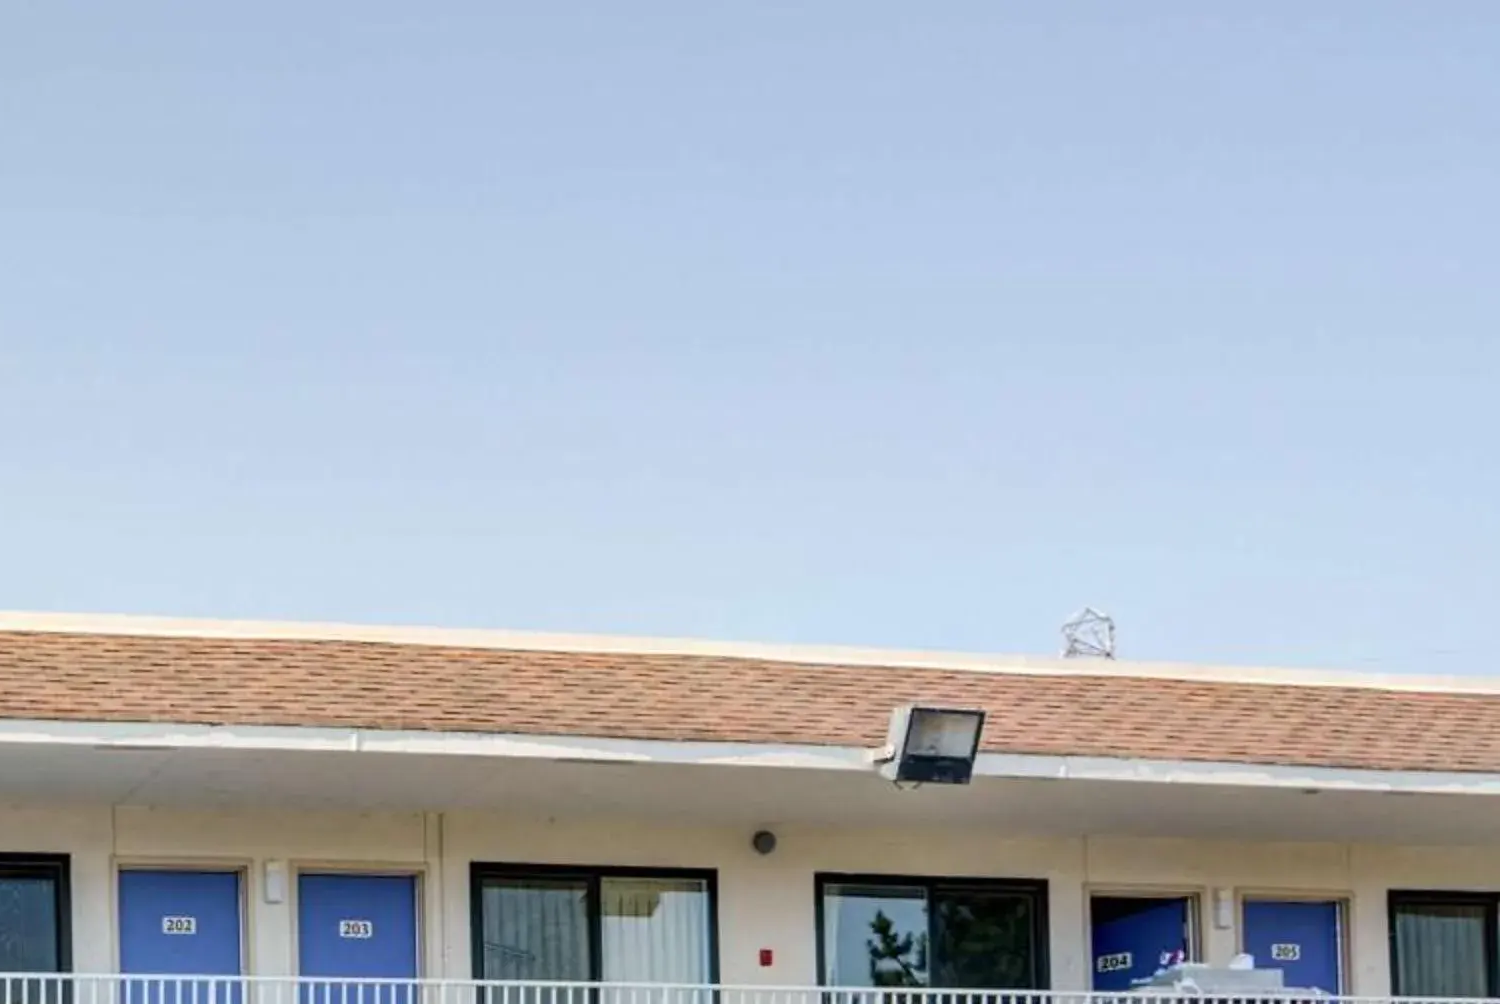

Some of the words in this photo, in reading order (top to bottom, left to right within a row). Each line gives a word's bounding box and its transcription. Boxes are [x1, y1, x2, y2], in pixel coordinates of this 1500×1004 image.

[166, 918, 193, 931] 202
[343, 922, 369, 935] 203
[1275, 945, 1297, 959] 205
[1101, 955, 1127, 969] 204
